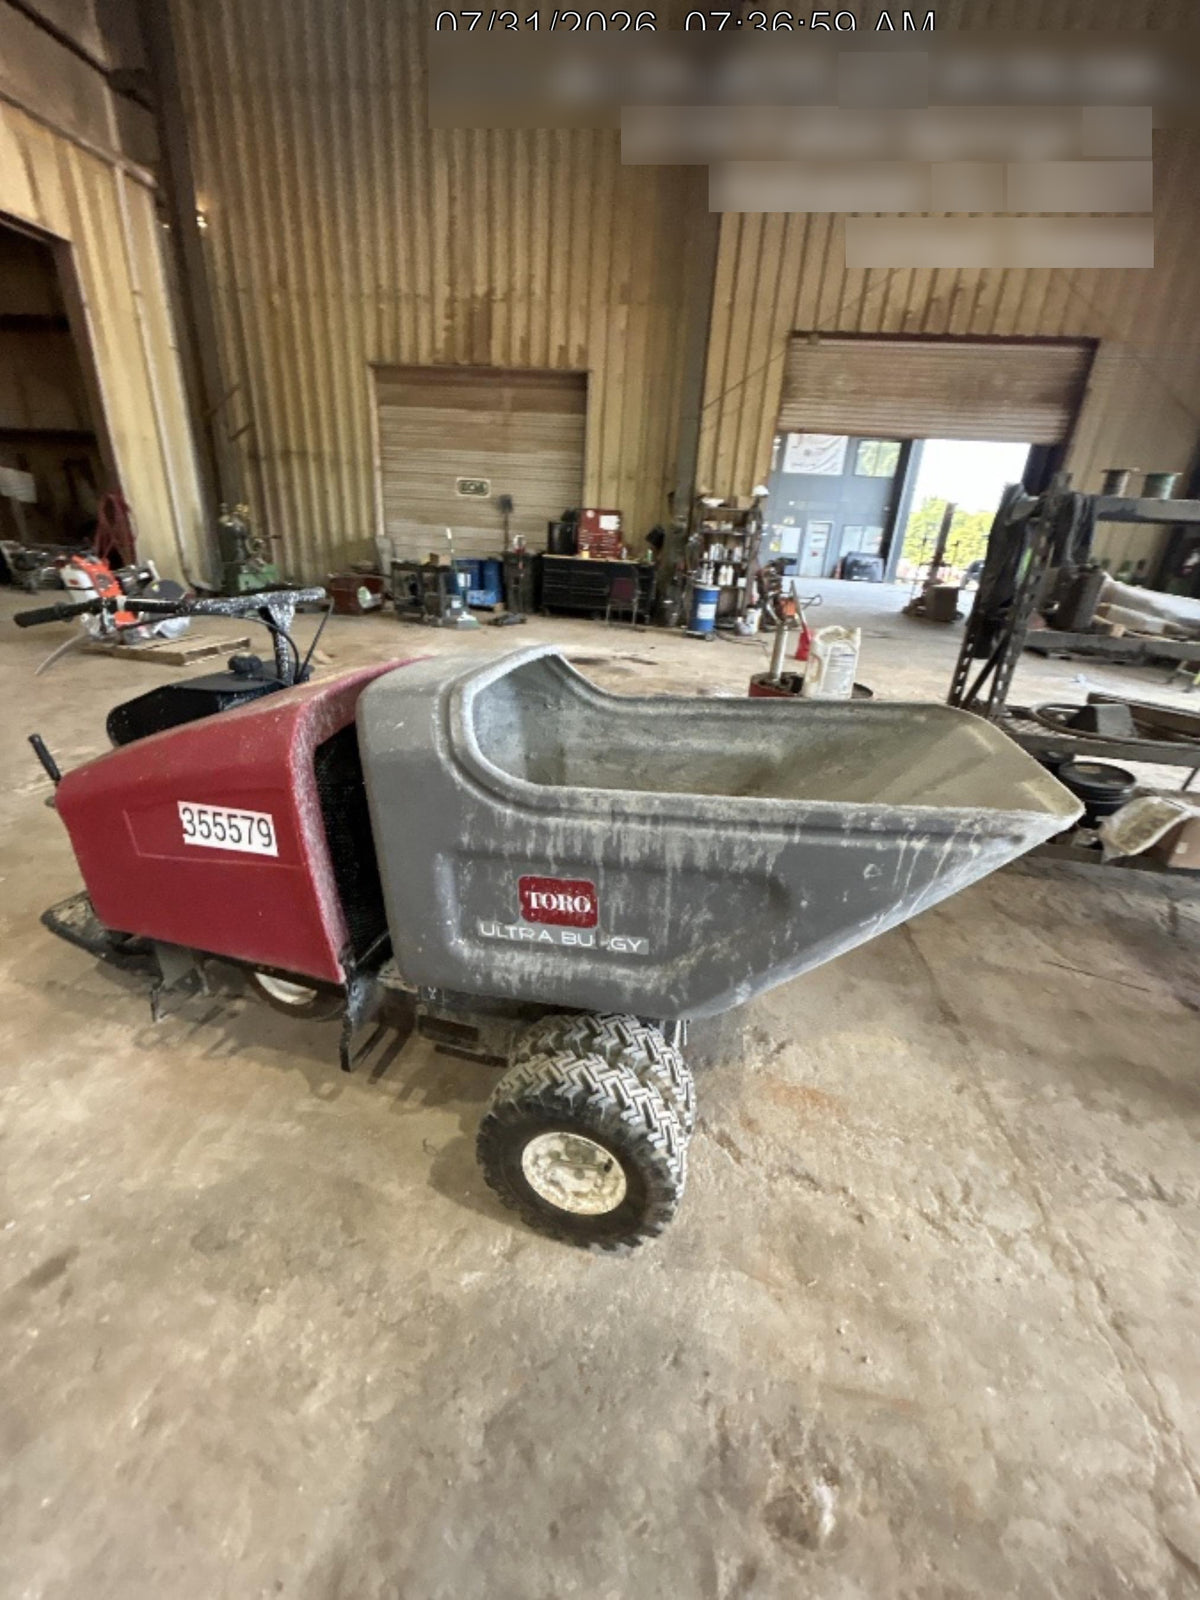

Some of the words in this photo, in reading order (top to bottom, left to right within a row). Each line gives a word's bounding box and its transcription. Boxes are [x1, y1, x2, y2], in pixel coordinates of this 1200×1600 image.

[182, 806, 273, 848] 355579
[525, 890, 592, 914] TORO
[479, 922, 554, 945] ULTRA
[561, 930, 642, 952] BUGY
